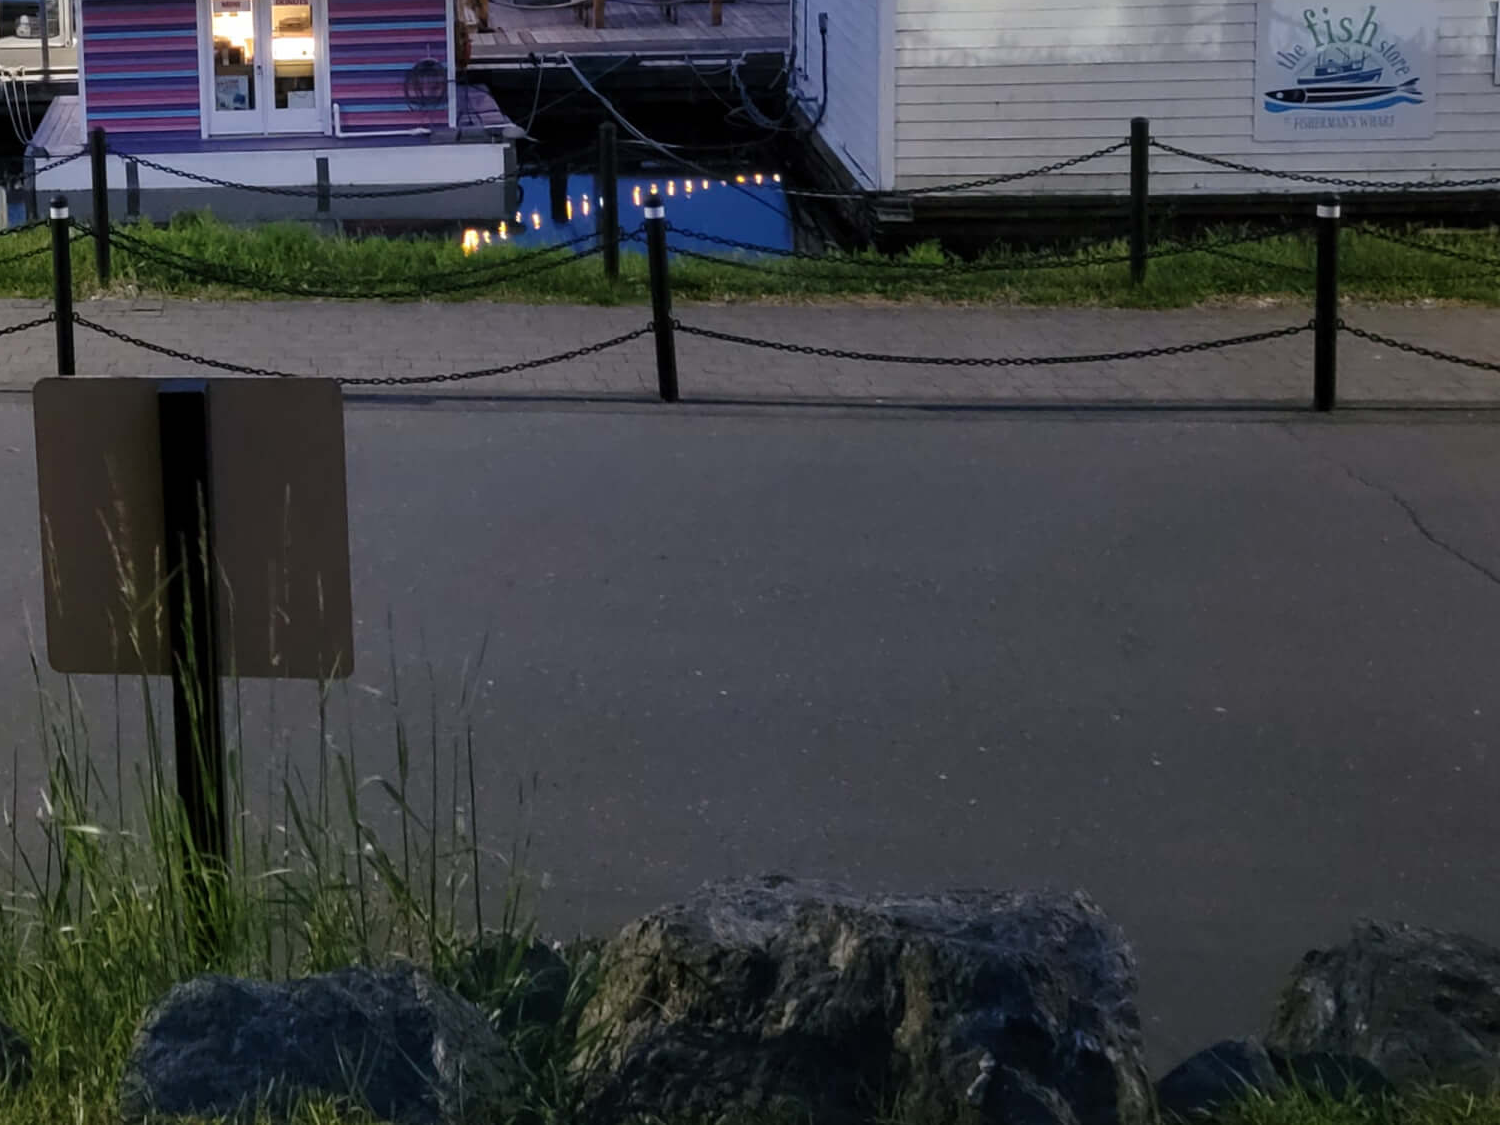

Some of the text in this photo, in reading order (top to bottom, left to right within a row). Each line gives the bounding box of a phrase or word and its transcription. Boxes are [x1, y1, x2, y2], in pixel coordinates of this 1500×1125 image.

[1276, 6, 1410, 77] the fish store
